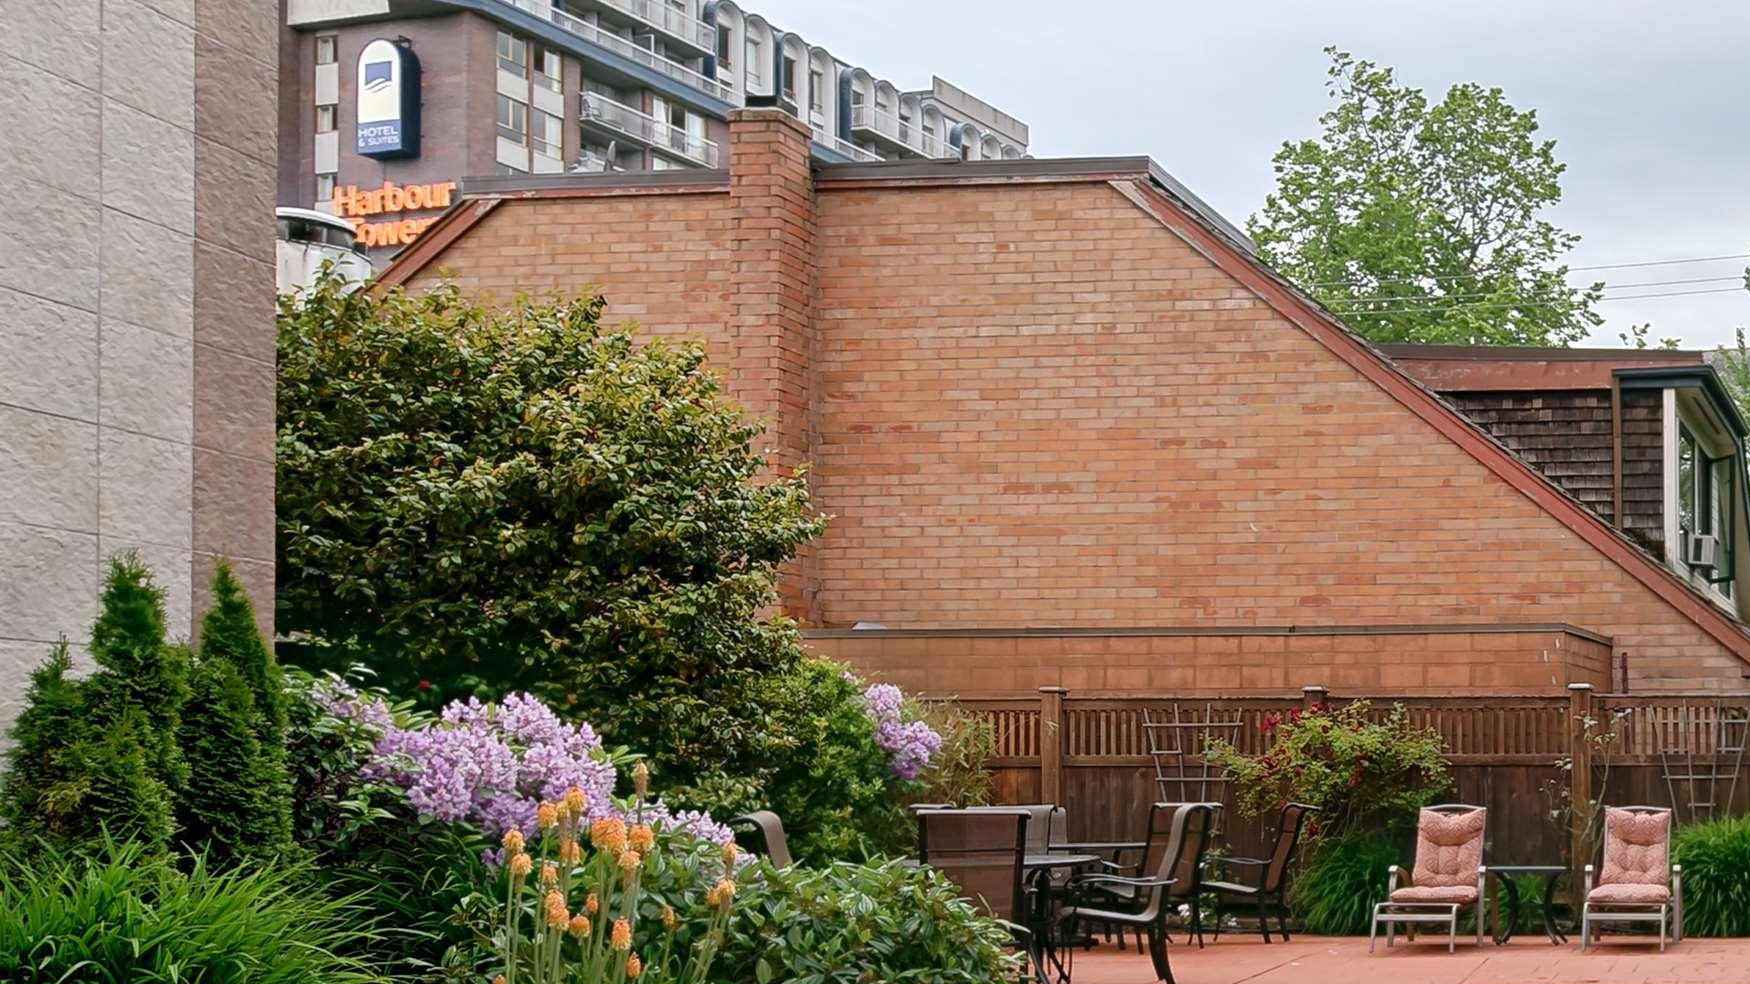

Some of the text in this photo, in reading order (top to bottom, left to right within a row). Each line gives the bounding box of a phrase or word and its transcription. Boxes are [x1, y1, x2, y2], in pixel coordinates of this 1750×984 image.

[358, 126, 398, 137] HOTEL
[368, 136, 399, 145] SUITES
[334, 181, 456, 215] Harbour
